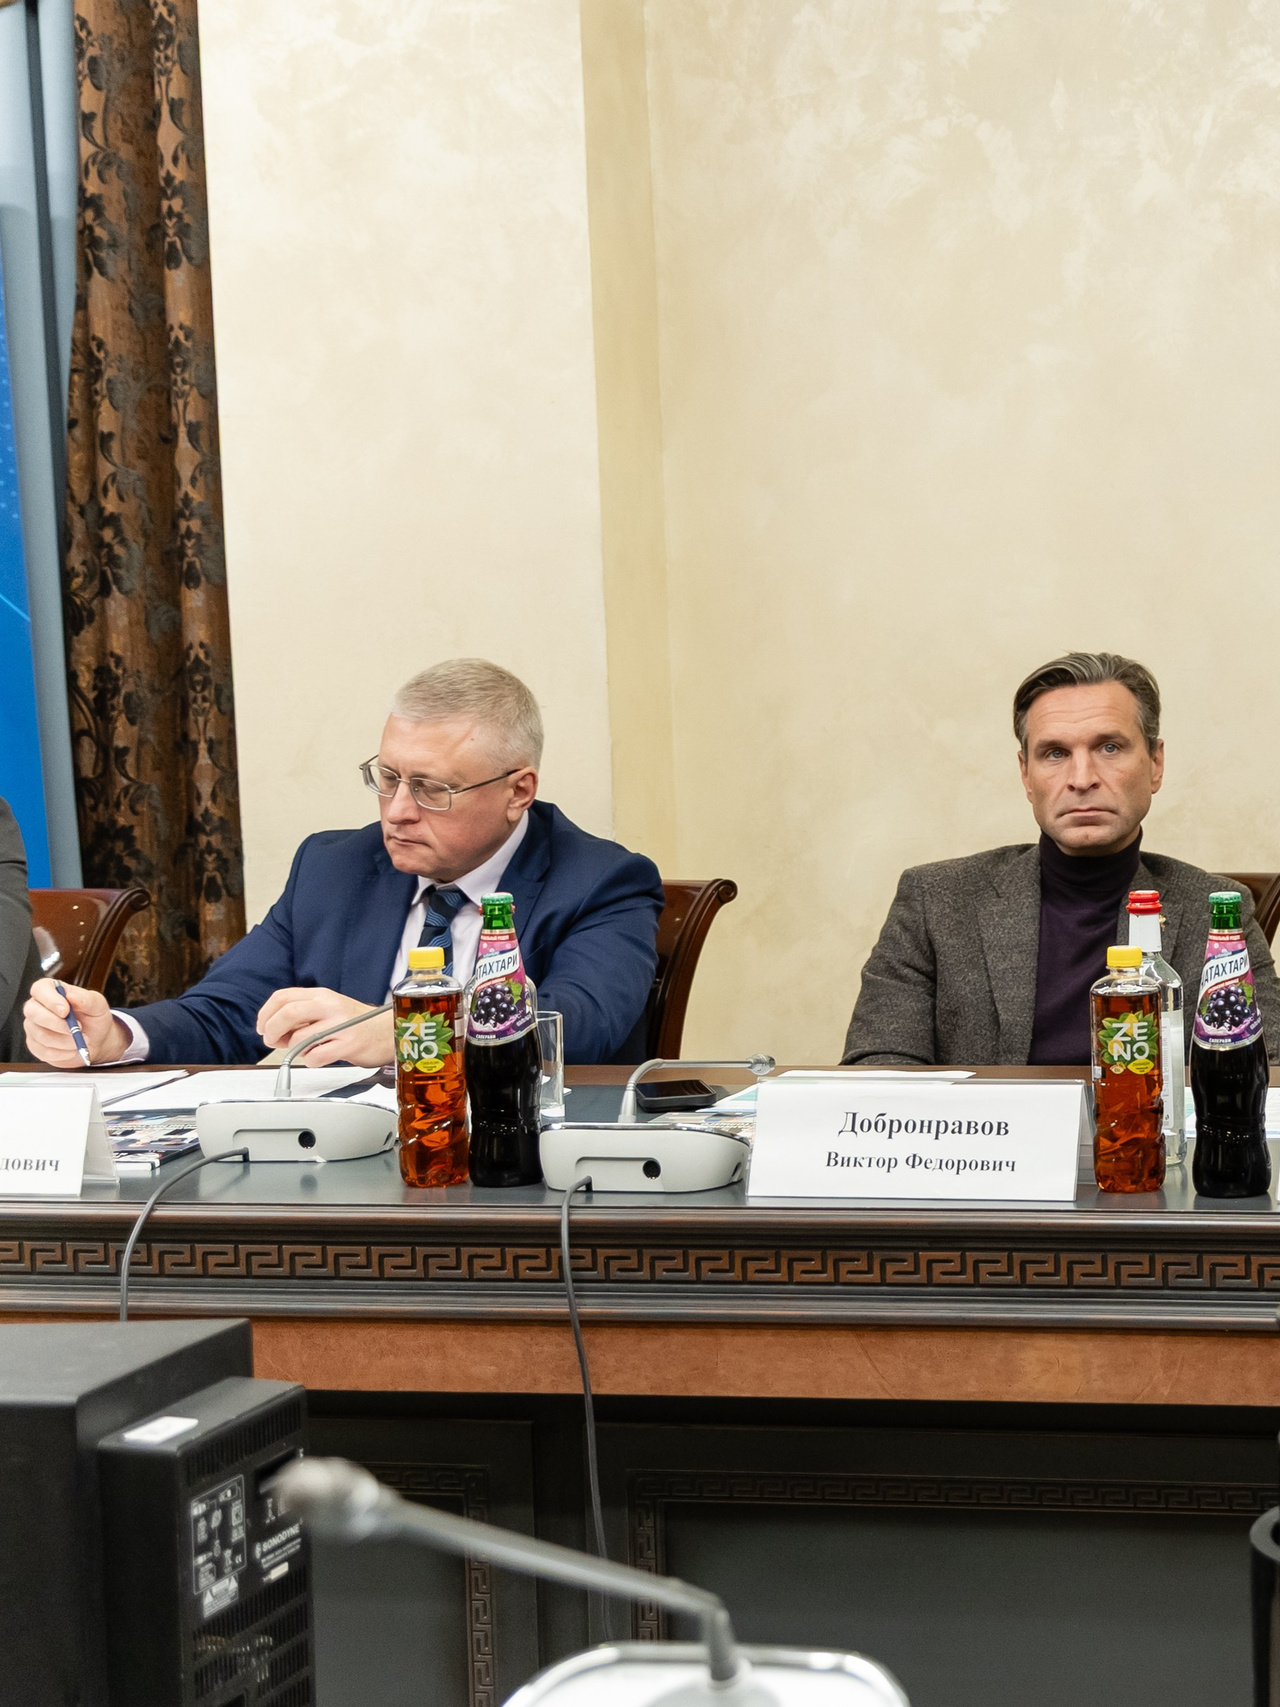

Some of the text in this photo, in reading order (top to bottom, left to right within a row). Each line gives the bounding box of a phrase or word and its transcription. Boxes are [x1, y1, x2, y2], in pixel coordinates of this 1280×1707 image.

[401, 1022, 437, 1041] ZE
[1111, 1022, 1148, 1041] ZE
[403, 1041, 439, 1060] NO
[1112, 1041, 1150, 1061] NO
[838, 1112, 1010, 1141] Добронравов
[825, 1151, 1017, 1175] Виктор Федорович
[262, 1523, 300, 1553] SONODYNE
